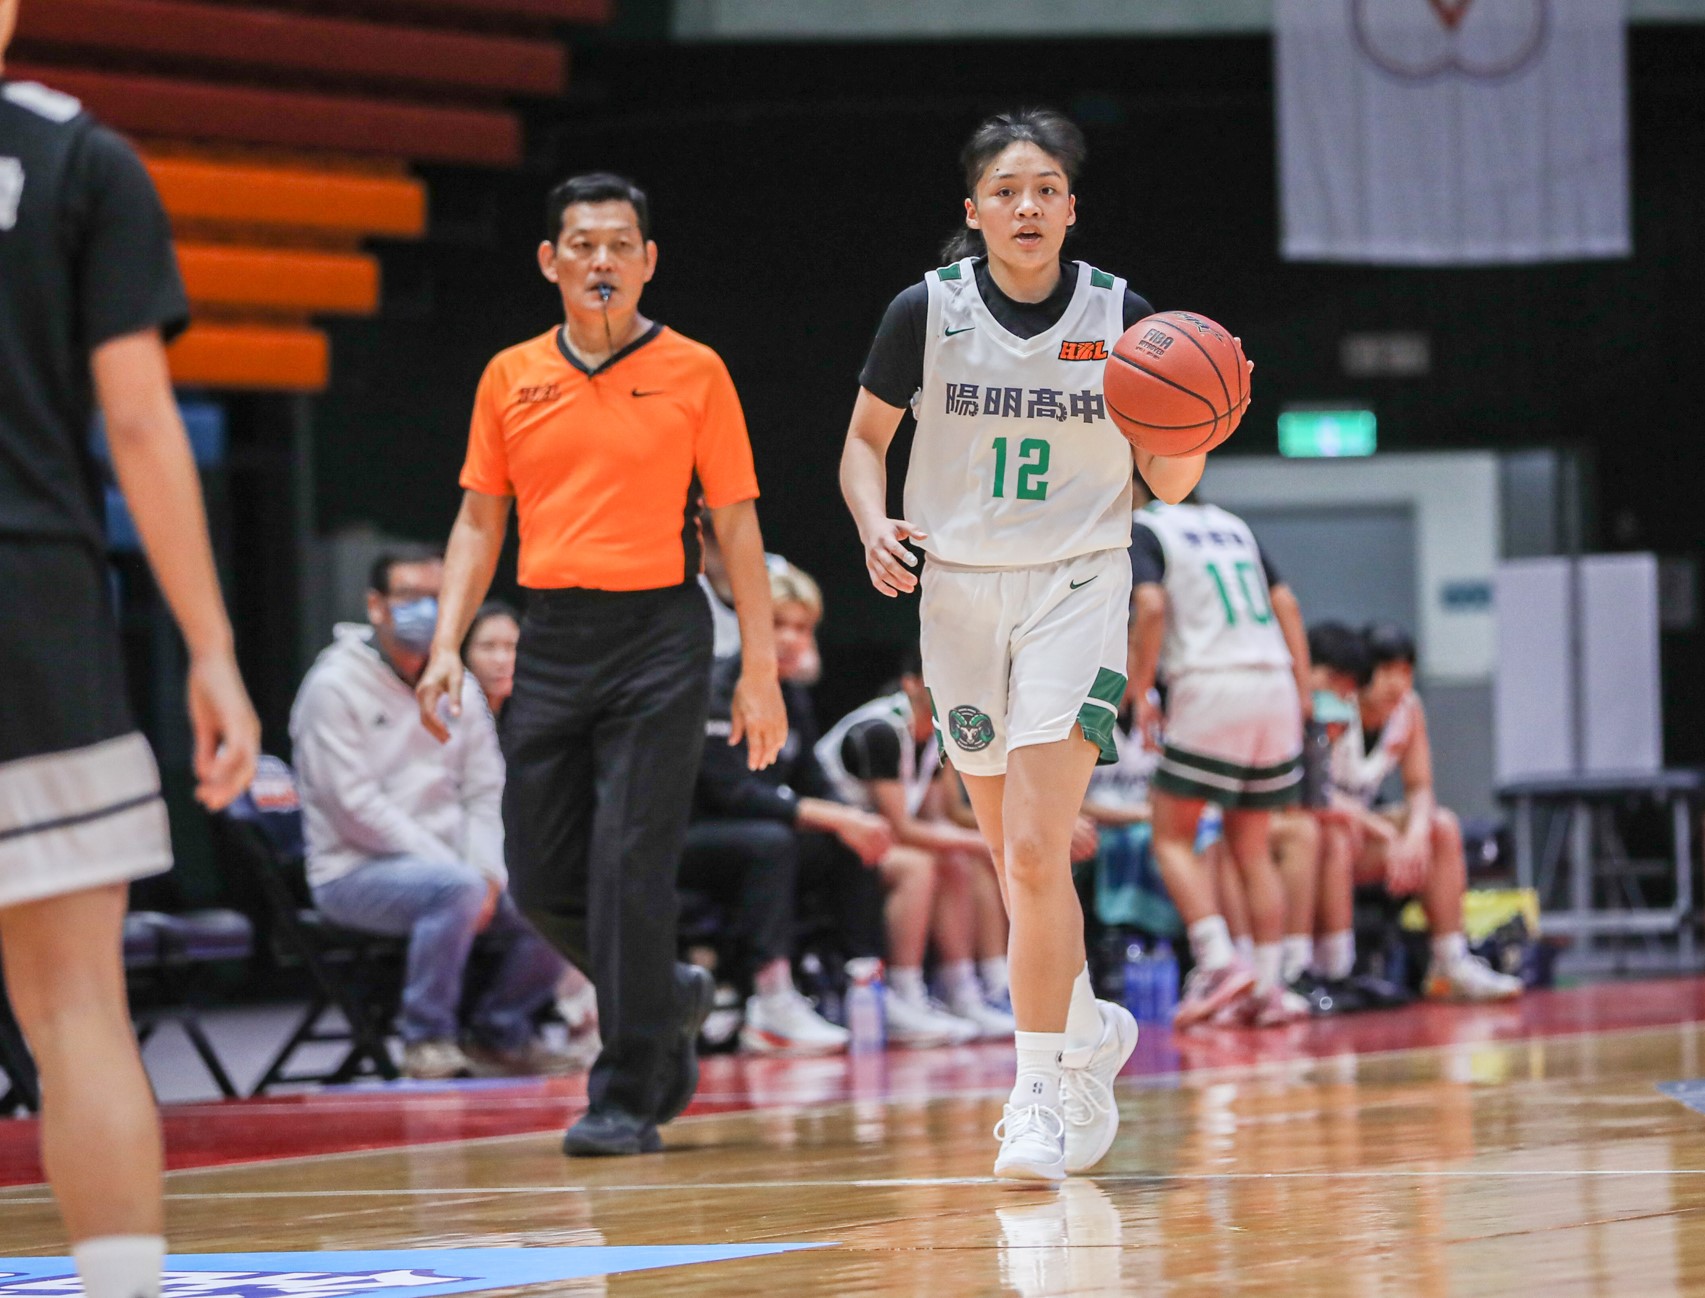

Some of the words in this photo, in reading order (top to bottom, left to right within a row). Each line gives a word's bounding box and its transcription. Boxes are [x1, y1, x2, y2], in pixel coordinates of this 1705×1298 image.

[1143, 328, 1175, 350] FIBA
[946, 383, 1106, 424] 陽明高中
[992, 437, 1051, 501] 12
[1206, 560, 1272, 626] 10
